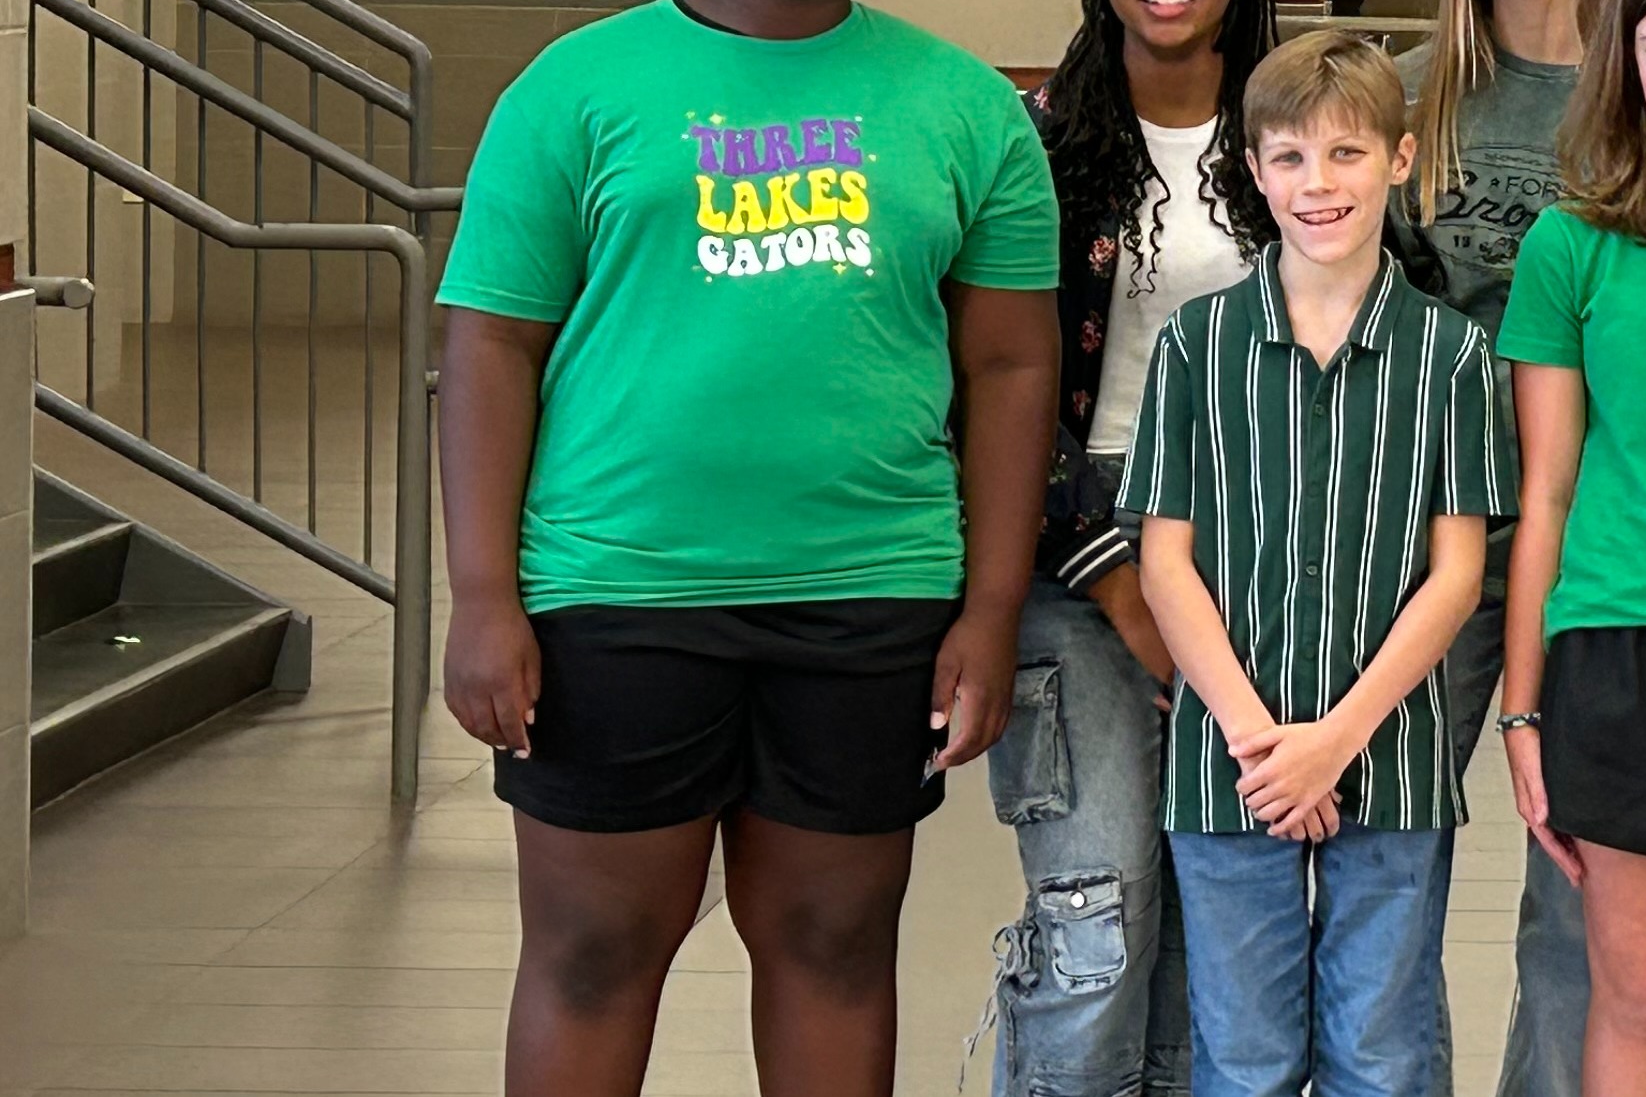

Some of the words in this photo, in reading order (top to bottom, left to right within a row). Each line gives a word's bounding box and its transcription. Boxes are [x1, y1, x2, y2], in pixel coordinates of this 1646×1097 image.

[690, 118, 862, 177] THREE
[696, 167, 870, 235] LAKES
[697, 224, 872, 277] GATORS
